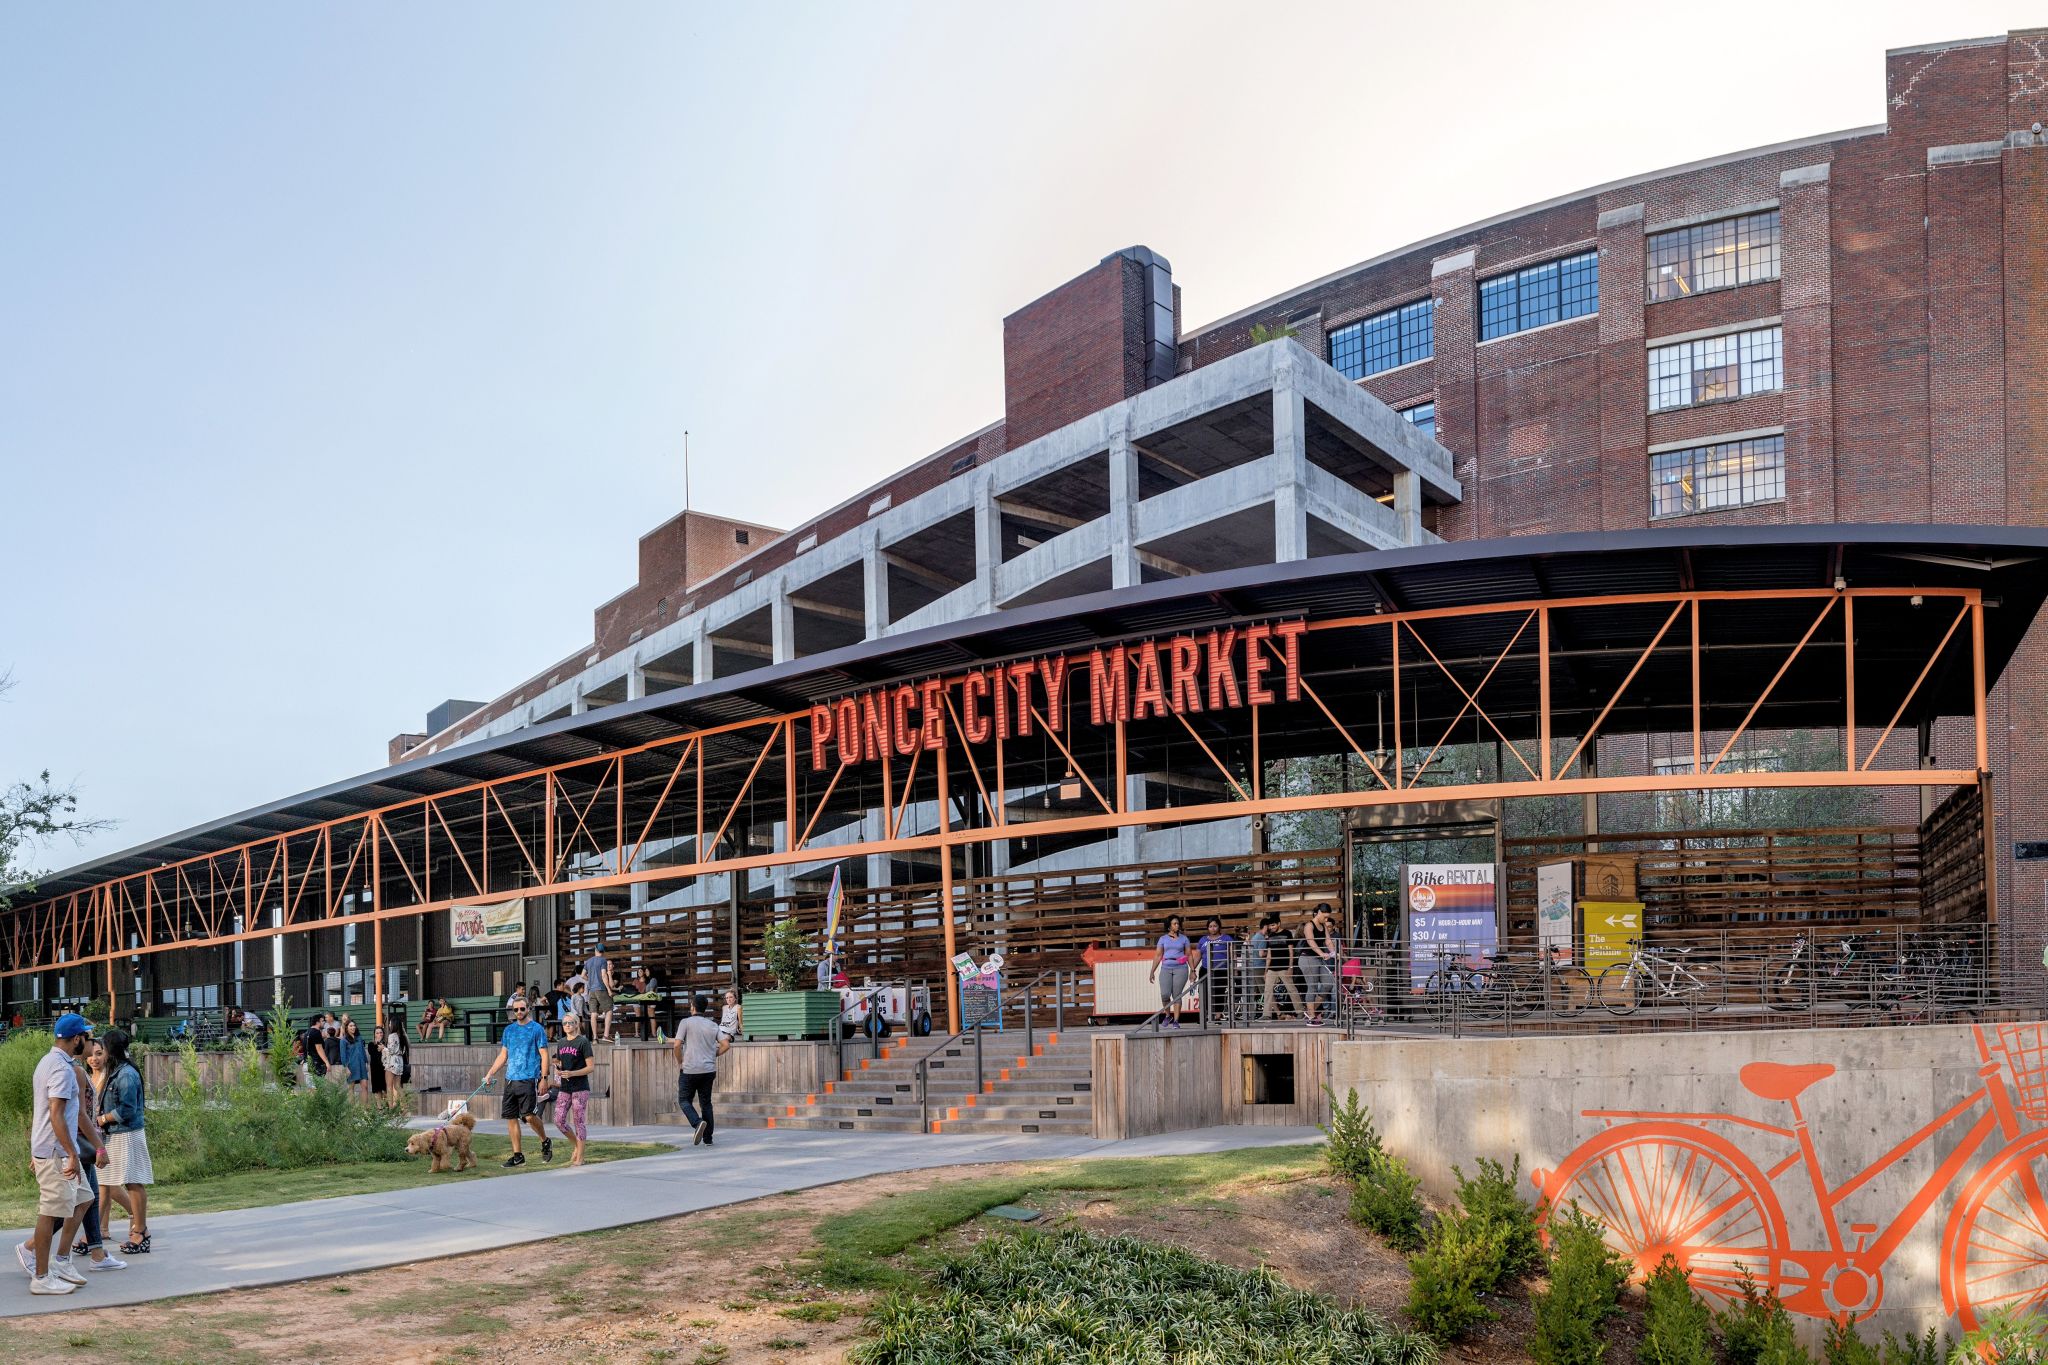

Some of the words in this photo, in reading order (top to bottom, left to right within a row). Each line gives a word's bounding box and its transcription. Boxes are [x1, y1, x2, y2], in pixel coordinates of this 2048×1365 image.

[810, 678, 948, 771] PONCE
[963, 655, 1069, 744] CITY
[1089, 620, 1309, 726] MARKET
[1412, 871, 1444, 885] Bike
[1446, 870, 1490, 884] RENTAL
[1414, 918, 1426, 927] $5
[1412, 931, 1429, 940] $30
[1589, 934, 1605, 942] The
[559, 1046, 577, 1056] MIAMI
